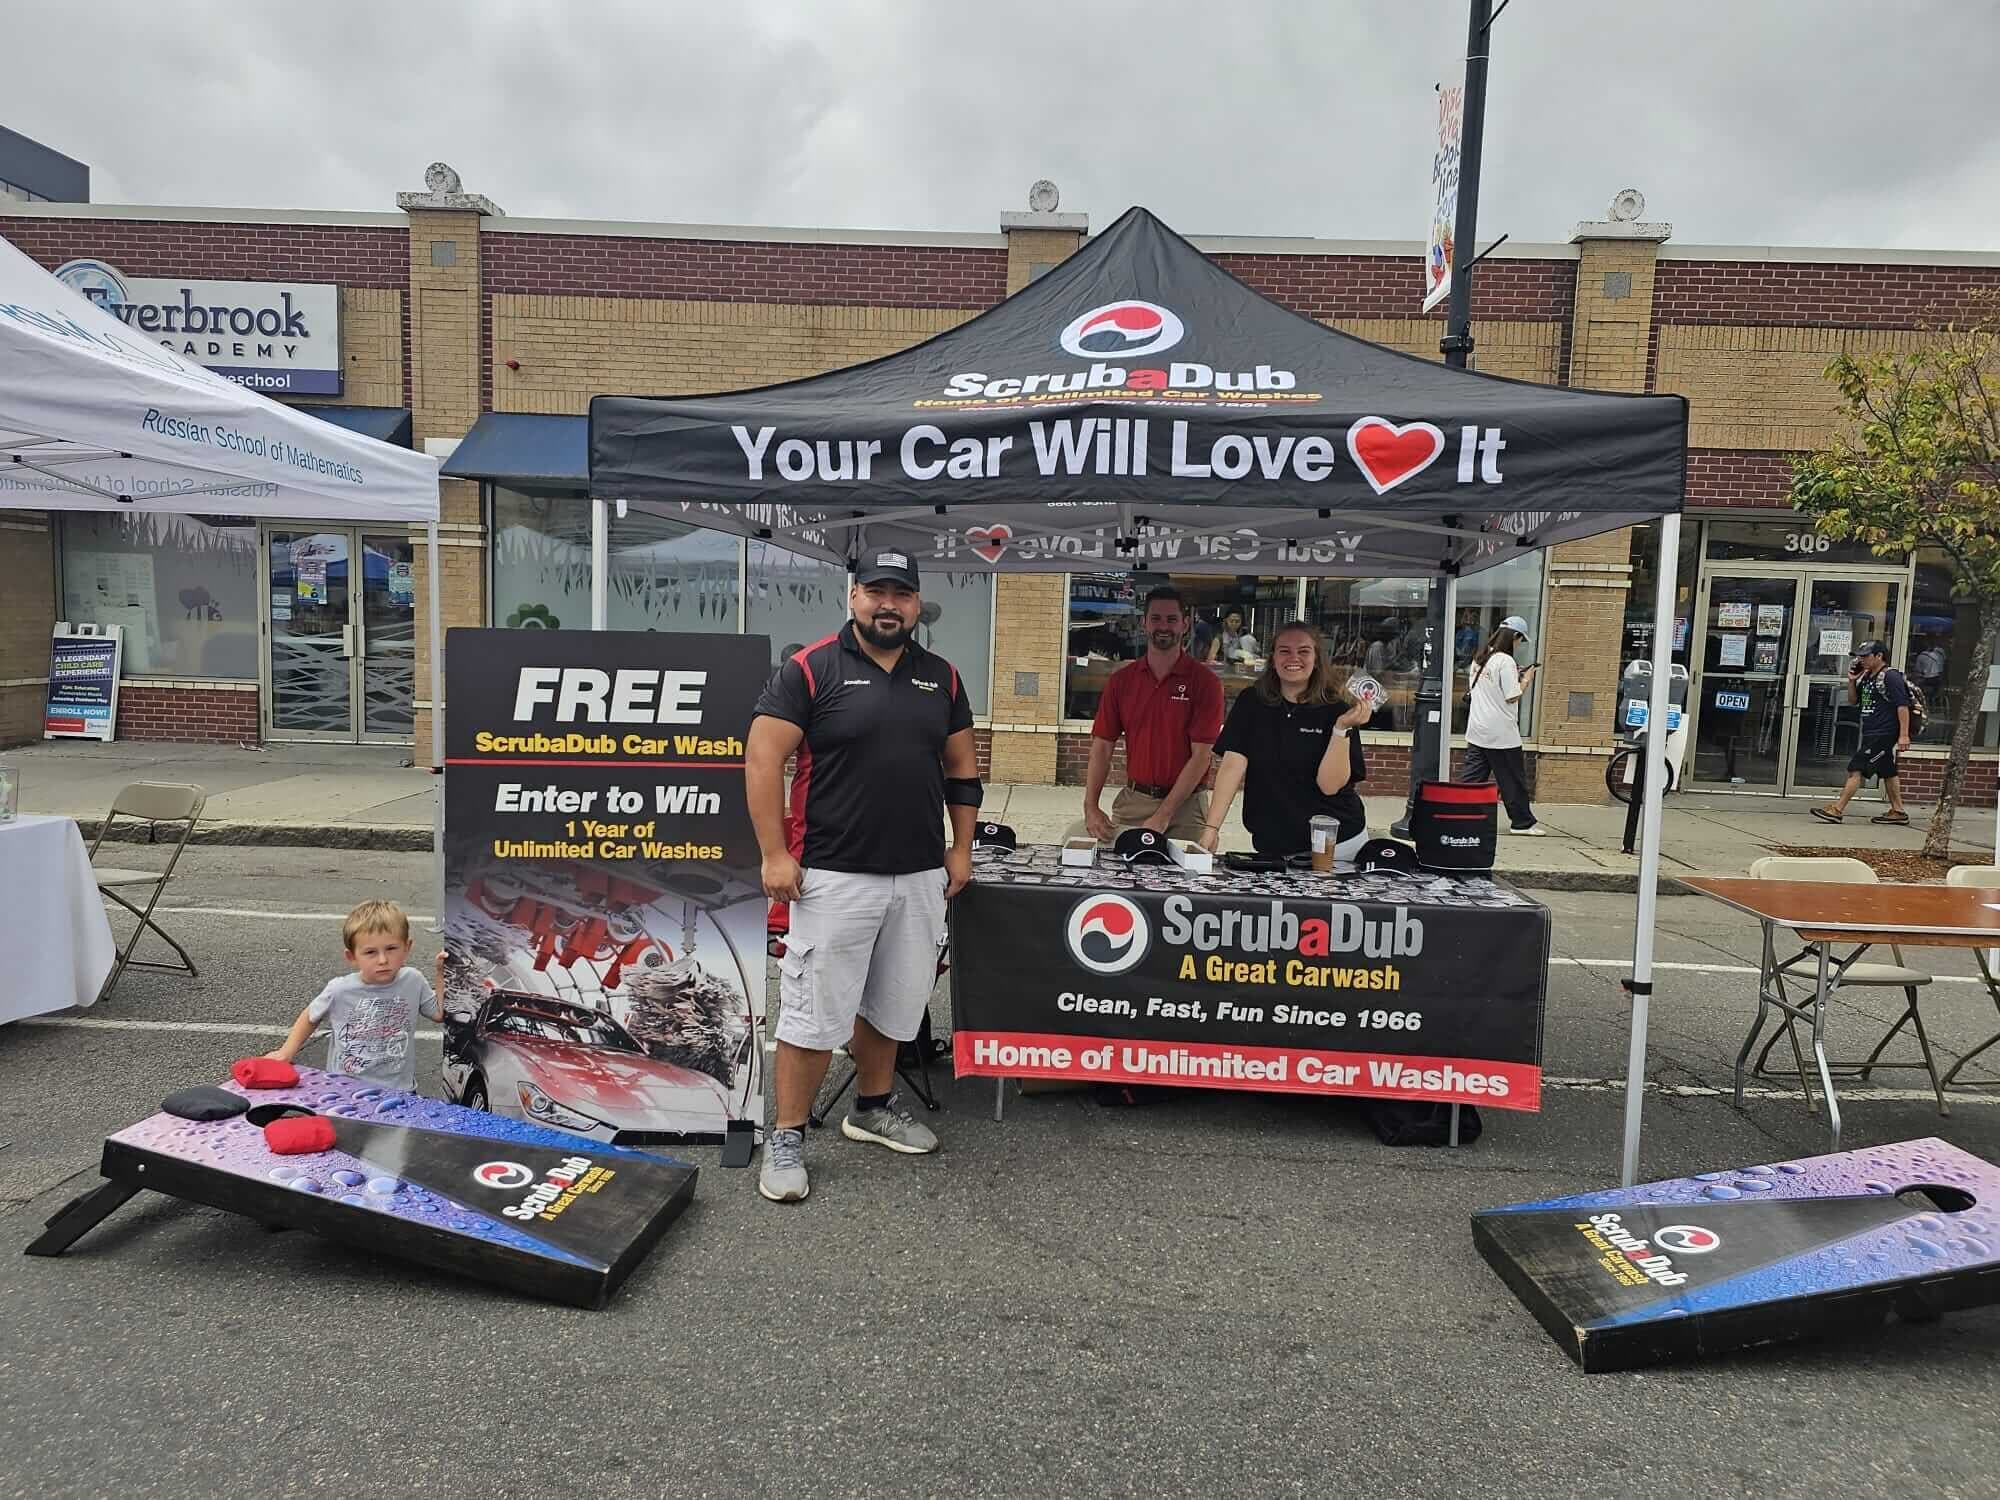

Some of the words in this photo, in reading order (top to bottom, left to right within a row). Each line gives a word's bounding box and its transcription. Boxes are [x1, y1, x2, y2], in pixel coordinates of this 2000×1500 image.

[943, 362, 1297, 398] ScrubaDub
[1162, 390, 1210, 398] Car
[1216, 391, 1323, 400] Washes
[142, 408, 212, 445] Russian
[215, 426, 266, 457] School
[271, 441, 283, 461] of
[286, 445, 364, 485] Mathematics
[730, 425, 882, 482] Your
[899, 424, 1014, 481] Car
[1029, 418, 1149, 477] Will
[1171, 420, 1335, 482] Love
[1457, 425, 1507, 484] It
[1784, 533, 1830, 552] 306
[55, 662, 79, 670] CHILD
[81, 661, 104, 669] CARE
[55, 668, 110, 677] EXPERIENCE!
[62, 654, 112, 663] LEGENDARY
[50, 707, 82, 715] ENROLL
[83, 708, 107, 716] NOW!
[513, 667, 707, 724] FREE
[1719, 695, 1746, 707] OPEN
[475, 731, 617, 754] ScrubaDub
[623, 735, 668, 755] Car
[674, 736, 744, 756] Wash
[495, 783, 597, 813] Enter
[606, 786, 644, 814] to
[655, 786, 721, 815] Win
[565, 821, 576, 838] 1
[582, 820, 628, 838] Year
[633, 821, 655, 838] of
[494, 840, 594, 859] Unlimited
[600, 841, 641, 859] Car
[642, 842, 723, 860] Washes
[1162, 895, 1424, 959] ScrubaDub
[1179, 955, 1197, 980] A
[1206, 956, 1277, 985] Great
[1285, 960, 1401, 991] Carwash
[1056, 992, 1138, 1019] Clean,
[1146, 998, 1207, 1023] Fast,
[1216, 1002, 1264, 1023] Fun
[1272, 1005, 1347, 1028] Since
[1356, 1009, 1423, 1031] 1966
[974, 1039, 1073, 1069] Home
[1080, 1045, 1115, 1070] of
[1122, 1047, 1288, 1082] Unlimited
[1296, 1056, 1361, 1086] Car
[1368, 1060, 1510, 1097] Washes
[502, 1156, 592, 1221] ScrubaDub
[546, 1192, 577, 1213] Great
[566, 1166, 607, 1195] Carwash
[1583, 1229, 1615, 1250] Great
[1604, 1249, 1650, 1285] Carwash
[1589, 1213, 1689, 1287] ScrubaDub
